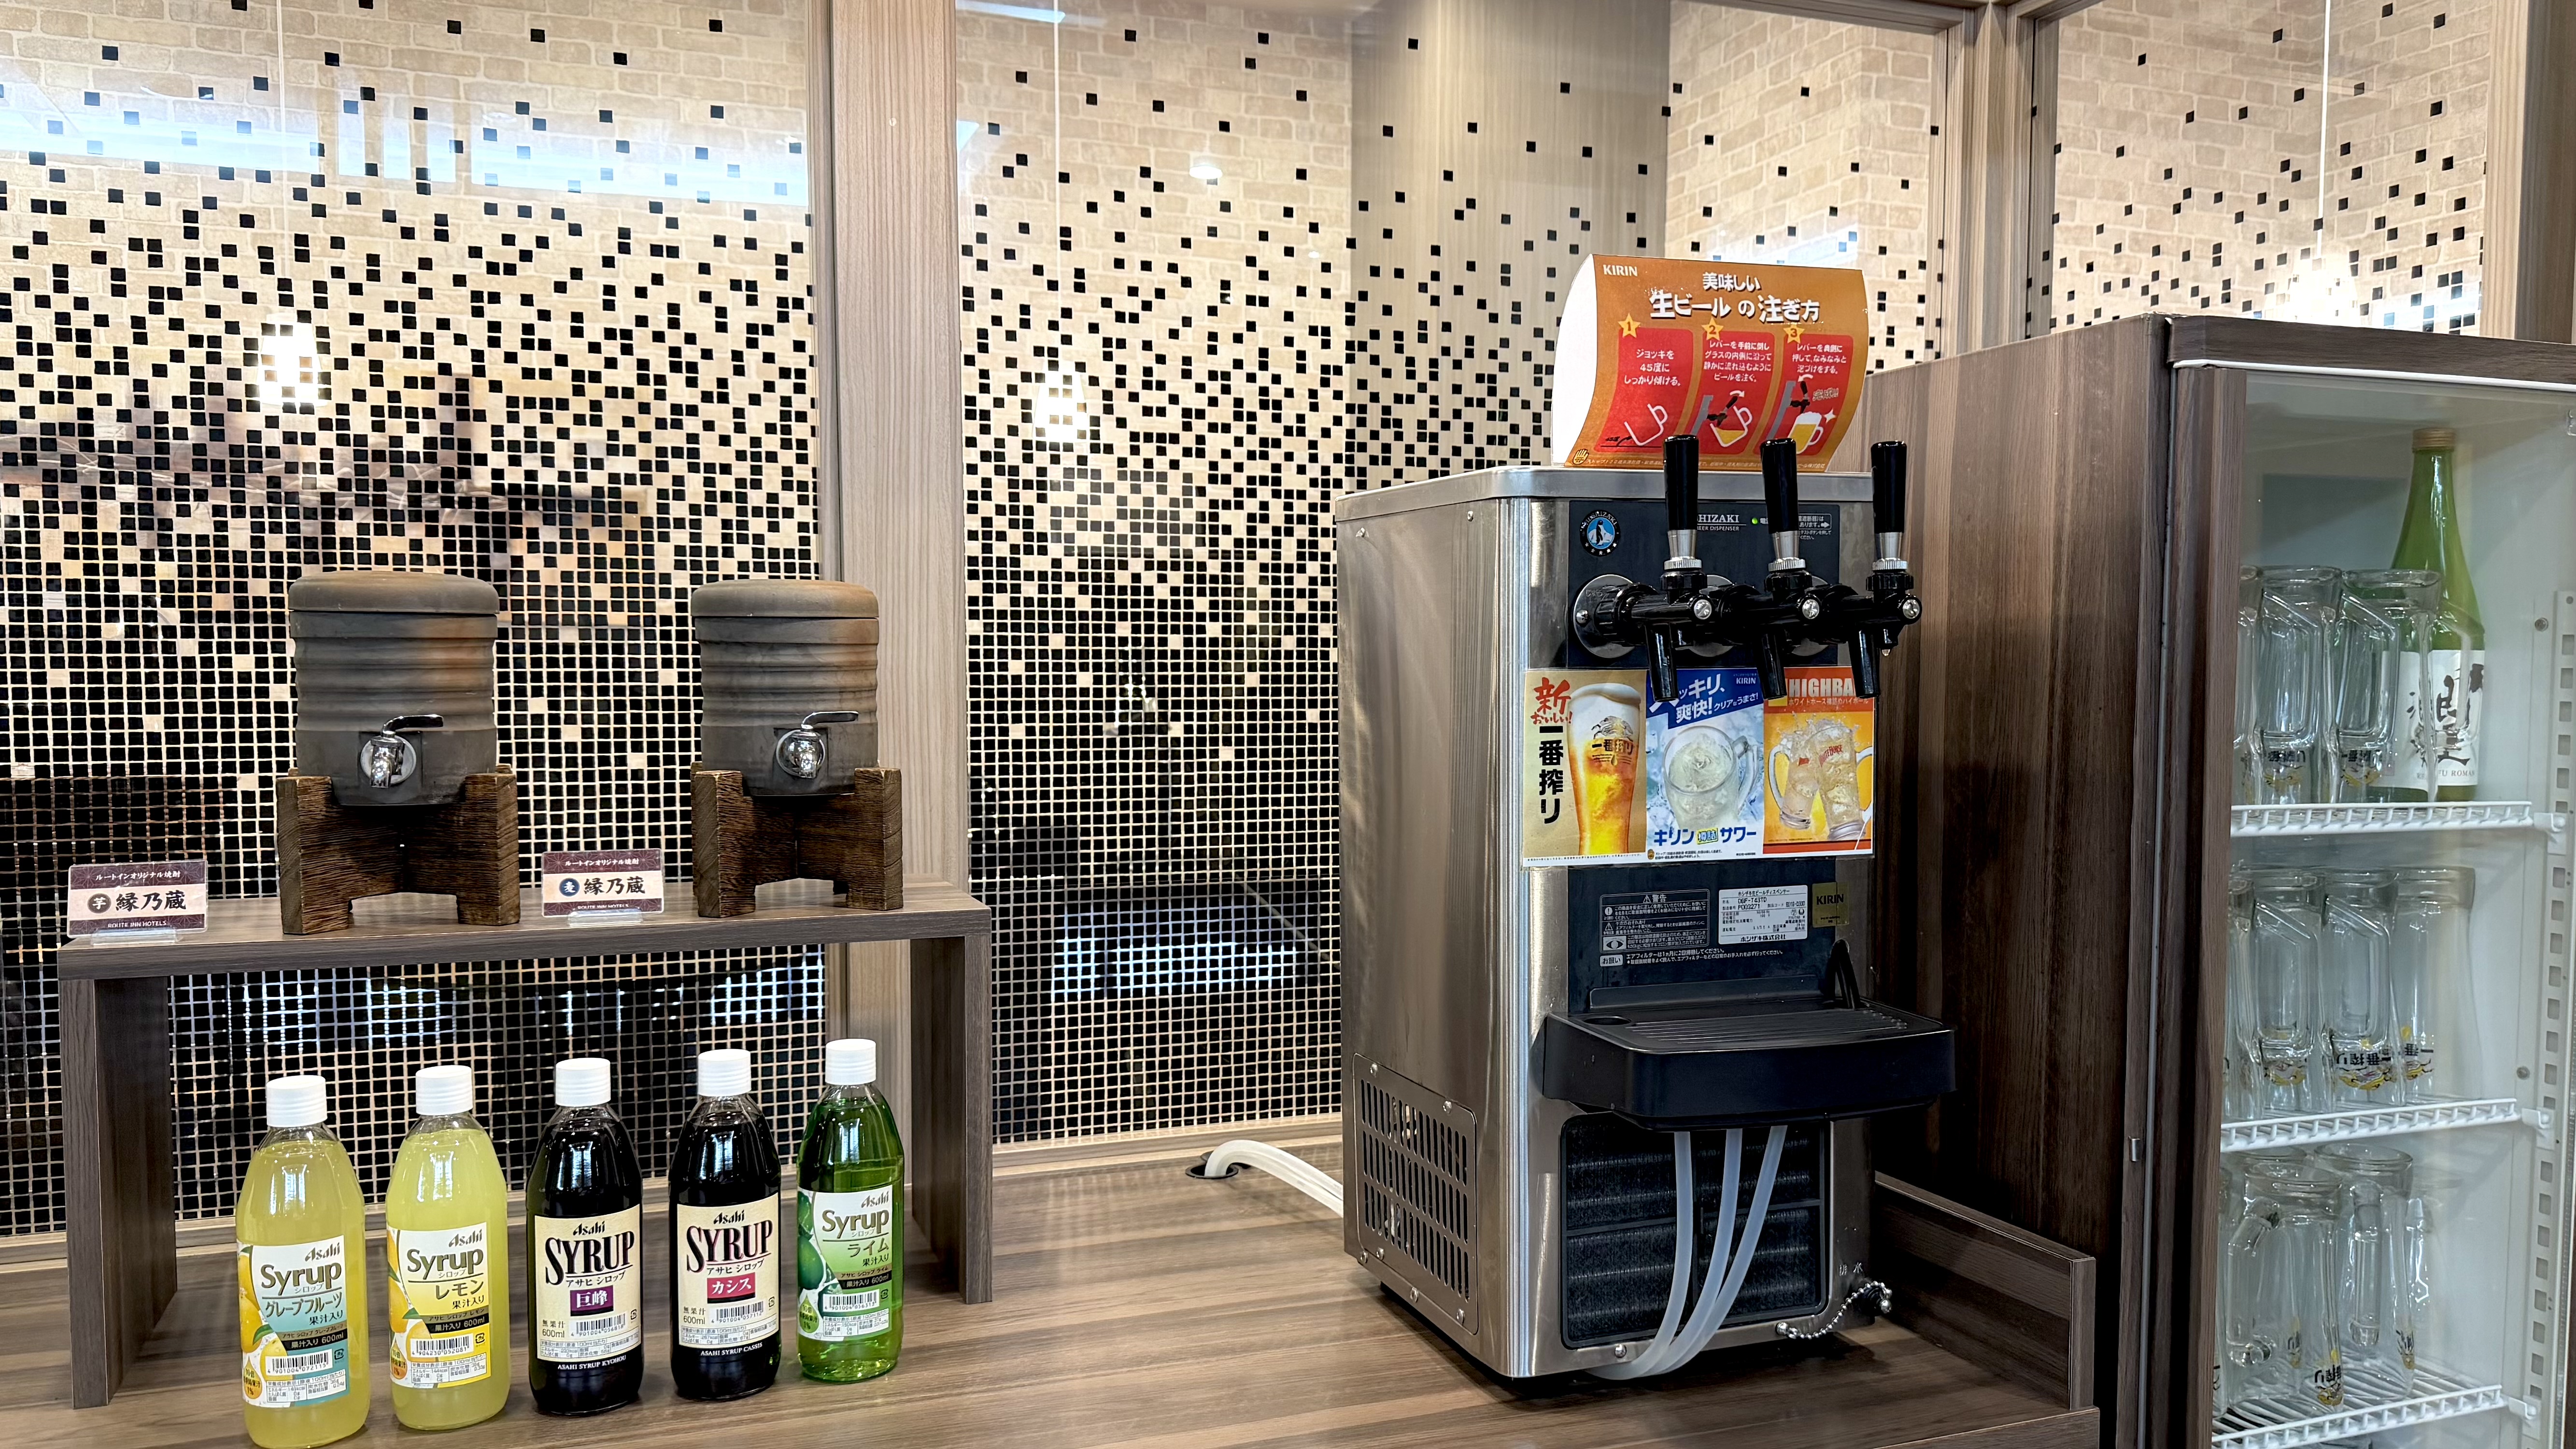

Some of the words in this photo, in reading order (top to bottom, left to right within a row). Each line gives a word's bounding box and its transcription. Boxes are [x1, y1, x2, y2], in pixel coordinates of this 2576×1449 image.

[1603, 264, 1638, 276] KIRIN
[1702, 272, 1762, 292] 美味しい
[1627, 321, 1631, 331] 1
[1709, 325, 1716, 335] 2
[1790, 328, 1798, 338] 3
[1636, 349, 1674, 360] ジョッキを
[1640, 363, 1670, 372] 45度に
[1624, 375, 1681, 386] しっかり傾ける。
[1697, 514, 1740, 523] HIZAKI
[1533, 677, 1571, 714] 新
[1530, 711, 1573, 724] おいしい!
[1539, 725, 1563, 824] 一番搾り
[1654, 827, 1694, 846] キリン
[1720, 826, 1757, 843] サワー
[565, 858, 639, 867] ルートインオリジナル焼酎
[95, 870, 181, 881] ルートインオリジナル焼酎
[583, 875, 646, 895] 縁乃蔵
[92, 896, 106, 910] 芋
[115, 889, 187, 912] 縁乃蔵
[1816, 894, 1844, 905] KIRIN
[861, 1191, 889, 1208] Asahi
[713, 1209, 745, 1224] Asahi
[822, 1209, 890, 1239] Syrup
[573, 1221, 606, 1236] Asahi
[851, 1228, 876, 1238] シロップ
[449, 1229, 482, 1248] Asahi
[305, 1242, 340, 1262] Asahi
[686, 1220, 773, 1273] SYRUP
[848, 1237, 890, 1258] ライム
[407, 1249, 483, 1280] Syrup
[545, 1231, 635, 1285] SYRUP
[863, 1253, 889, 1267] 果汁入り
[438, 1269, 467, 1279] シロップ
[707, 1266, 732, 1276] アサヒ
[736, 1258, 764, 1273] シロップ
[260, 1262, 342, 1296] Syrup
[566, 1279, 593, 1288] アサヒ
[596, 1270, 626, 1285] シロップ
[711, 1278, 752, 1295] カシス
[846, 1279, 869, 1288] 果汁入り
[871, 1273, 890, 1284] 600ml
[294, 1283, 324, 1294] シロップ
[436, 1279, 484, 1300] レモン
[265, 1291, 342, 1318] グレープフルーツ
[452, 1295, 484, 1310] 果汁入り
[576, 1290, 608, 1308] 巨峰
[309, 1310, 343, 1325] 果汁入り
[683, 1306, 706, 1315] 無果汁
[435, 1322, 461, 1332] 果汁入り
[464, 1317, 485, 1328] 600ml
[542, 1319, 566, 1329] 無果汁
[683, 1316, 705, 1324] 600ml
[291, 1339, 319, 1349] 果汁入り
[321, 1332, 344, 1343] 600ml
[542, 1329, 565, 1338] 600ml
[722, 1348, 742, 1356] SYRUP
[743, 1342, 763, 1352] CASSIS
[579, 1362, 601, 1370] SYRUP
[602, 1354, 627, 1366] KYOHOU
